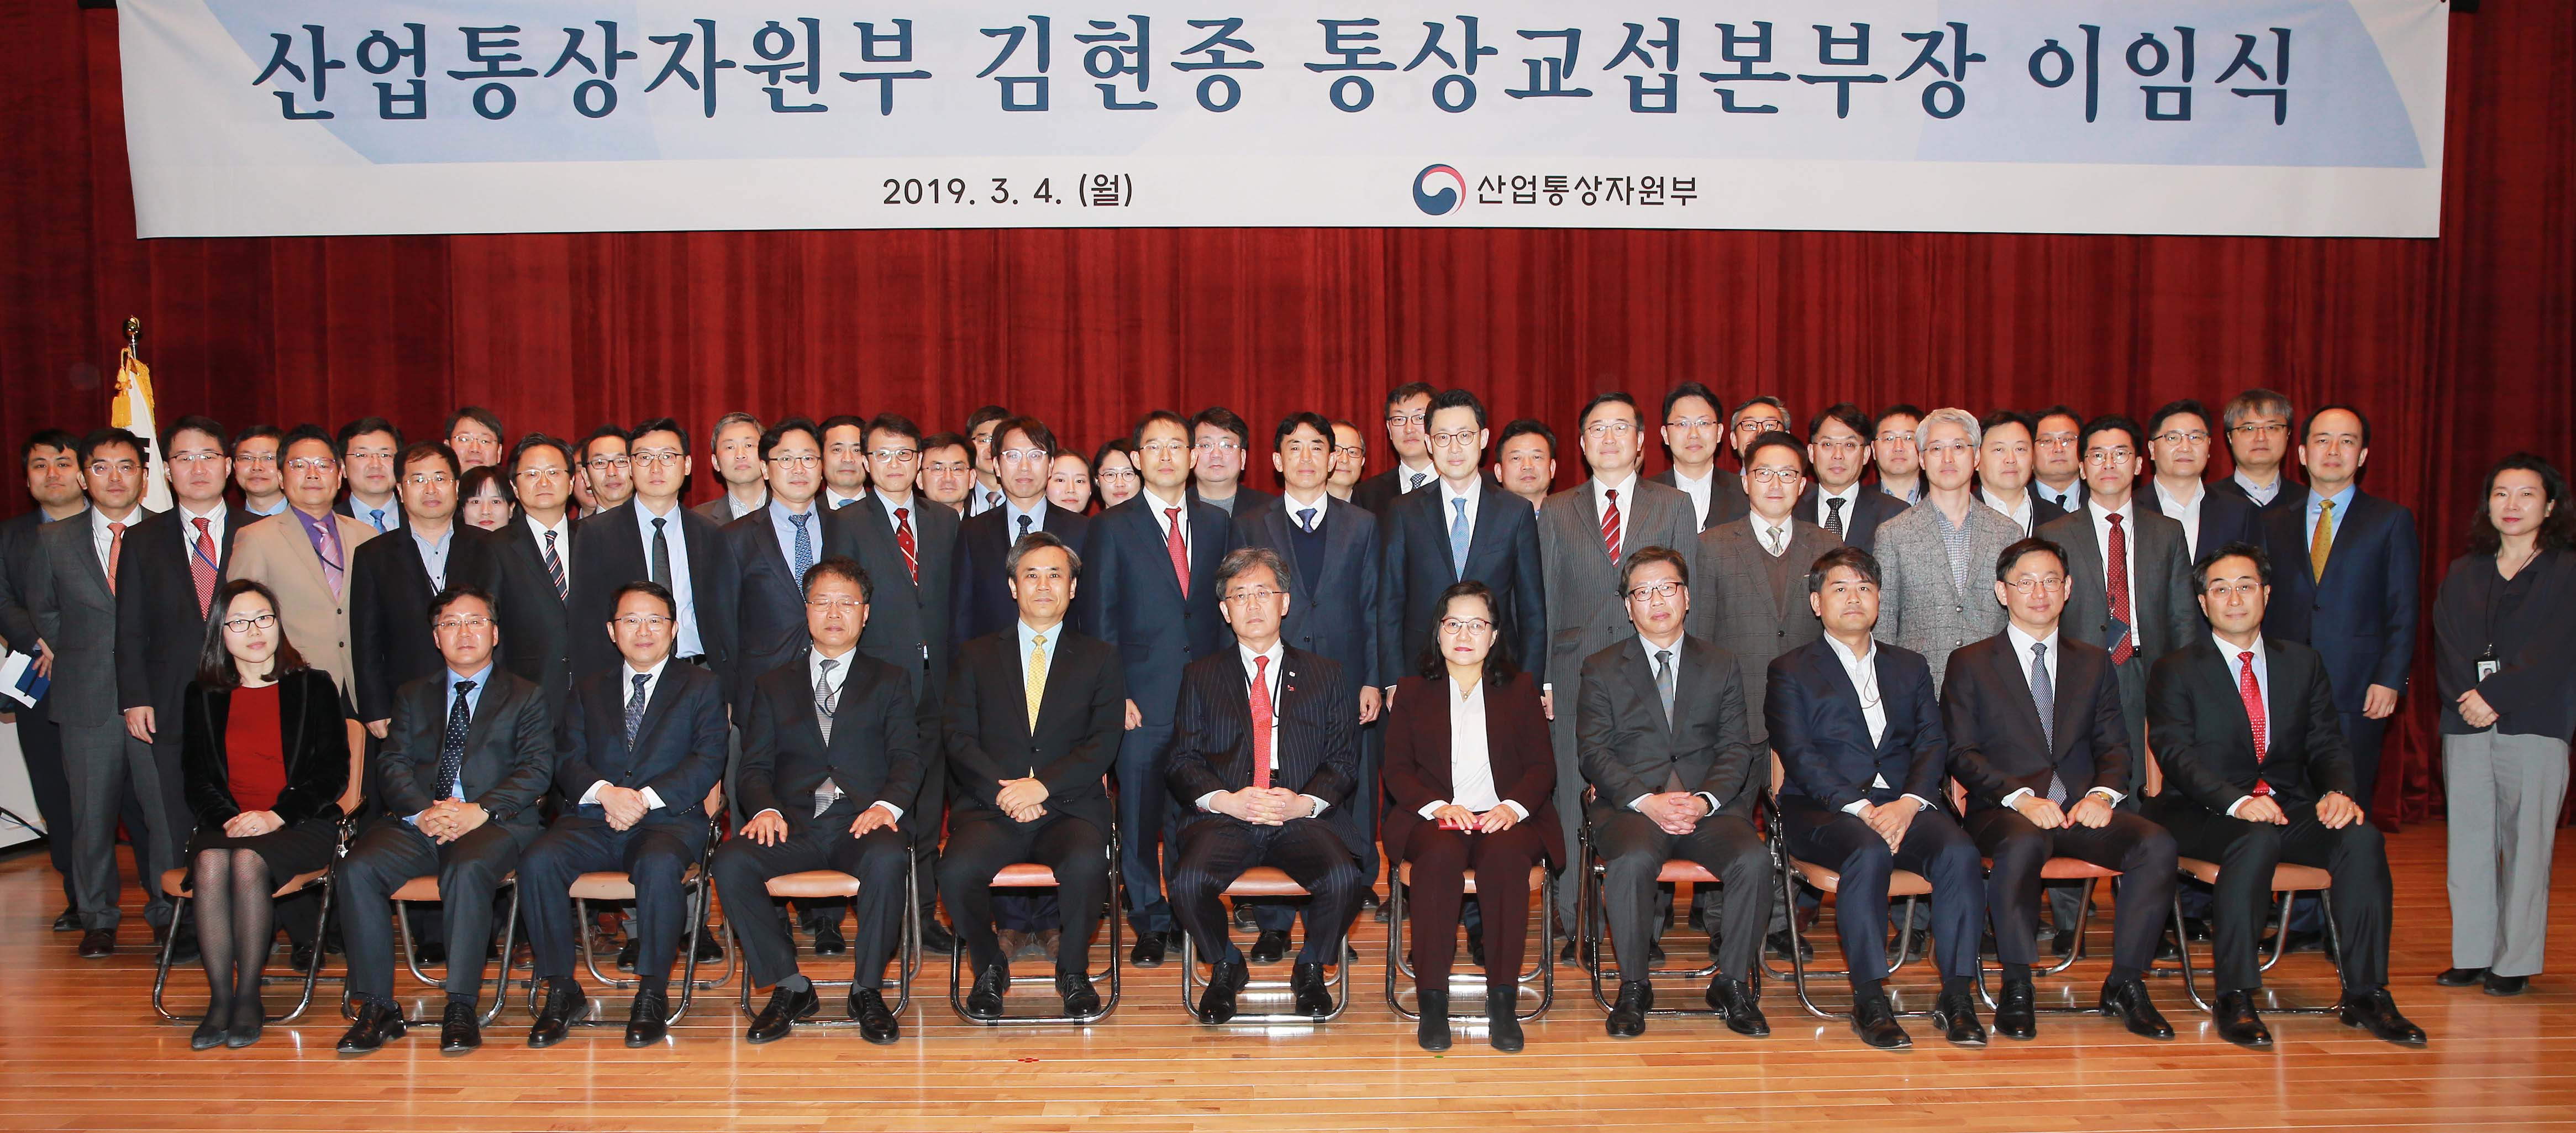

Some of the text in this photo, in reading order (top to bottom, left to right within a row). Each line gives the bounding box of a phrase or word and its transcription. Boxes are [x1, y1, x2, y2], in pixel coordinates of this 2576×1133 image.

[251, 14, 2292, 126] 산업통상자원부 김현종 통상교섭본부장 이임식
[883, 173, 1132, 207] 2019. 3. 4. (월)
[1477, 175, 1697, 206] 산업통상자원부
